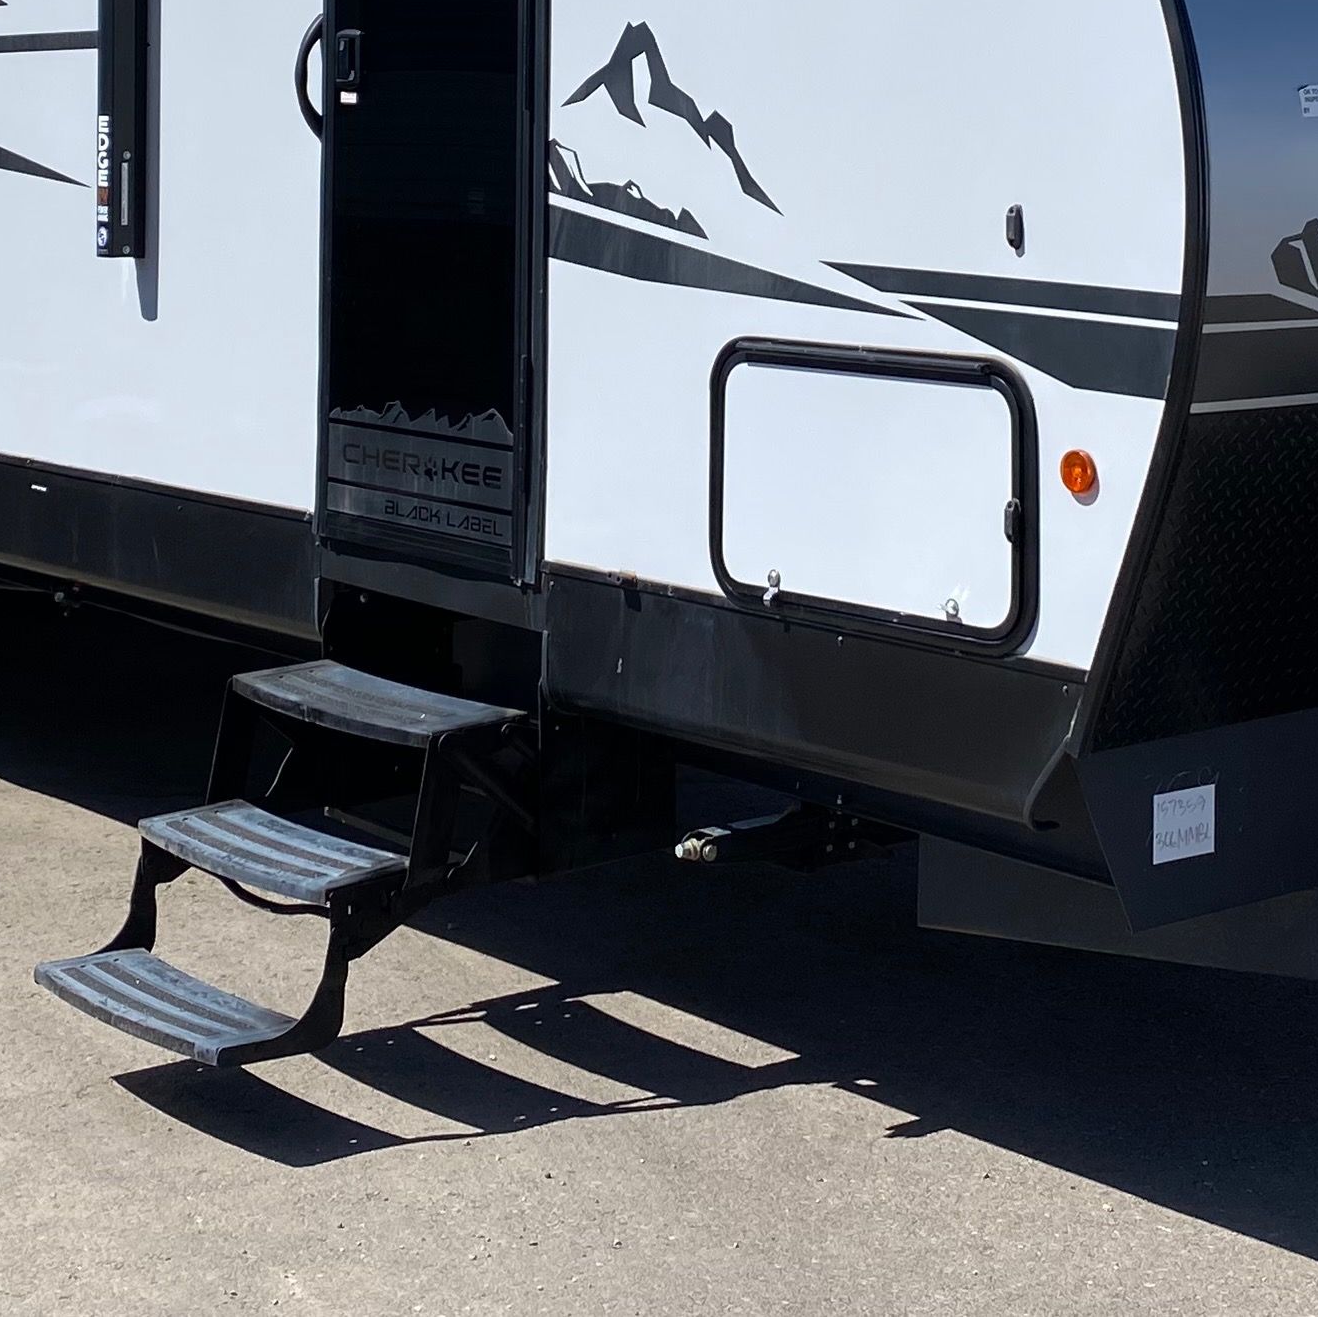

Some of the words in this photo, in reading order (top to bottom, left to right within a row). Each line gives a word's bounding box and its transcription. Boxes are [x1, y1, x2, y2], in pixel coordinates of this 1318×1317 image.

[97, 115, 110, 187] EDGE
[384, 499, 441, 524] BLACK
[446, 513, 504, 537] LABEL
